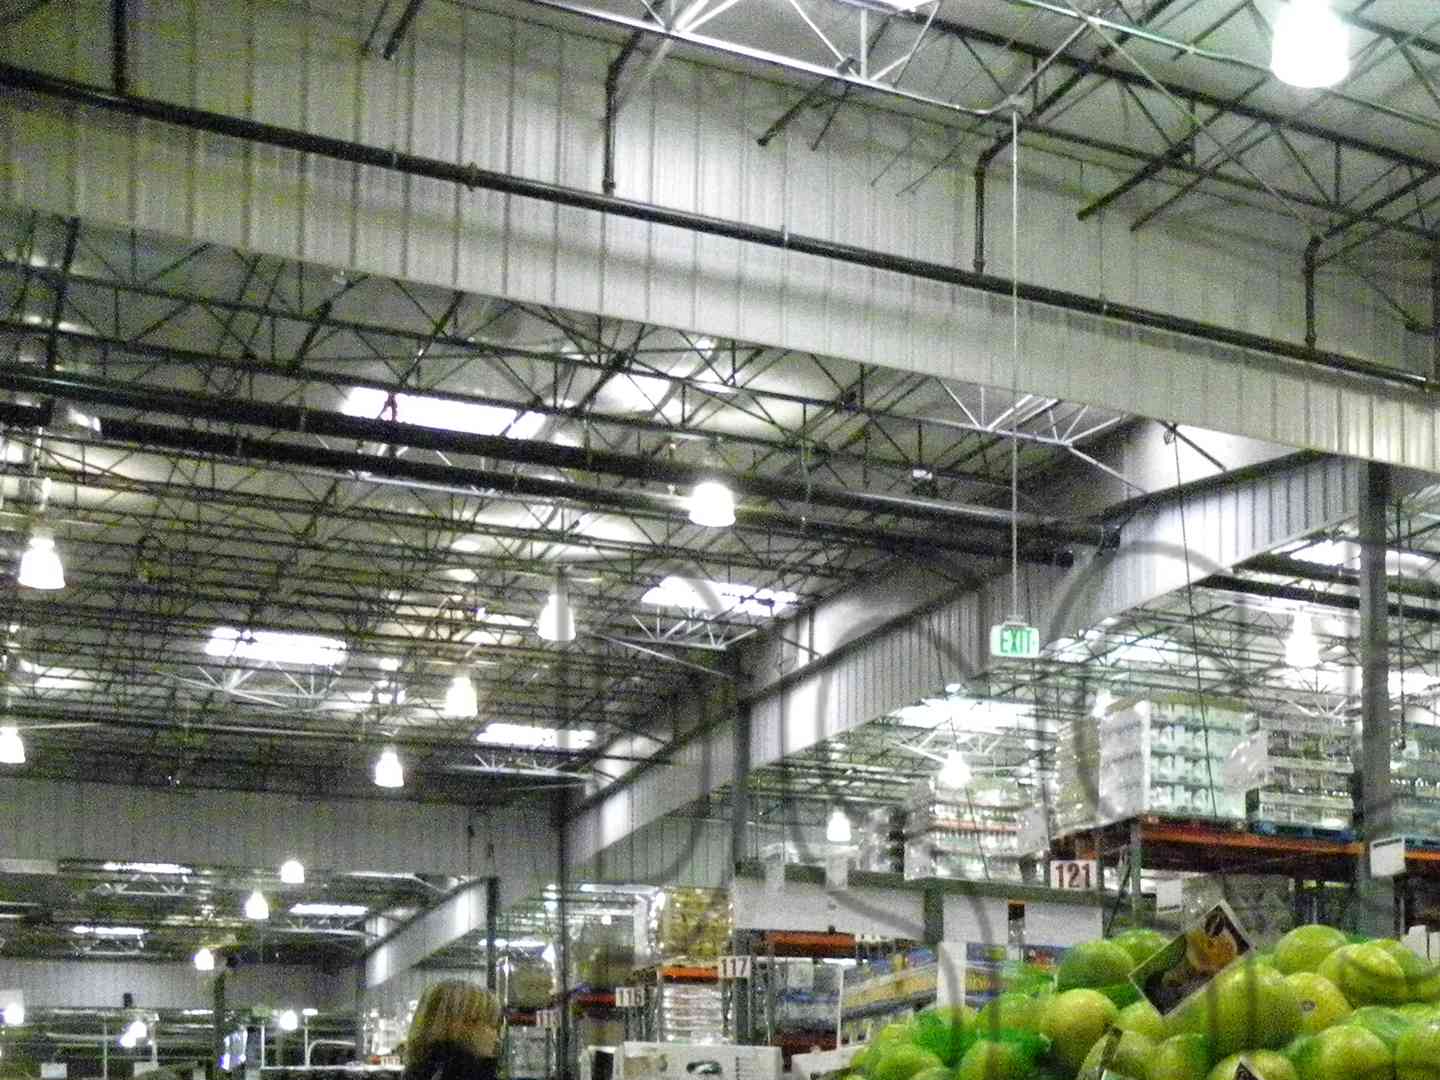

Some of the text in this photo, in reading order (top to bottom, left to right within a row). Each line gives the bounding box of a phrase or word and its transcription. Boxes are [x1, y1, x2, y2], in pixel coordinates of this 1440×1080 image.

[1000, 627, 1032, 654] EXIT
[1056, 864, 1091, 889] 121
[721, 957, 749, 977] 117
